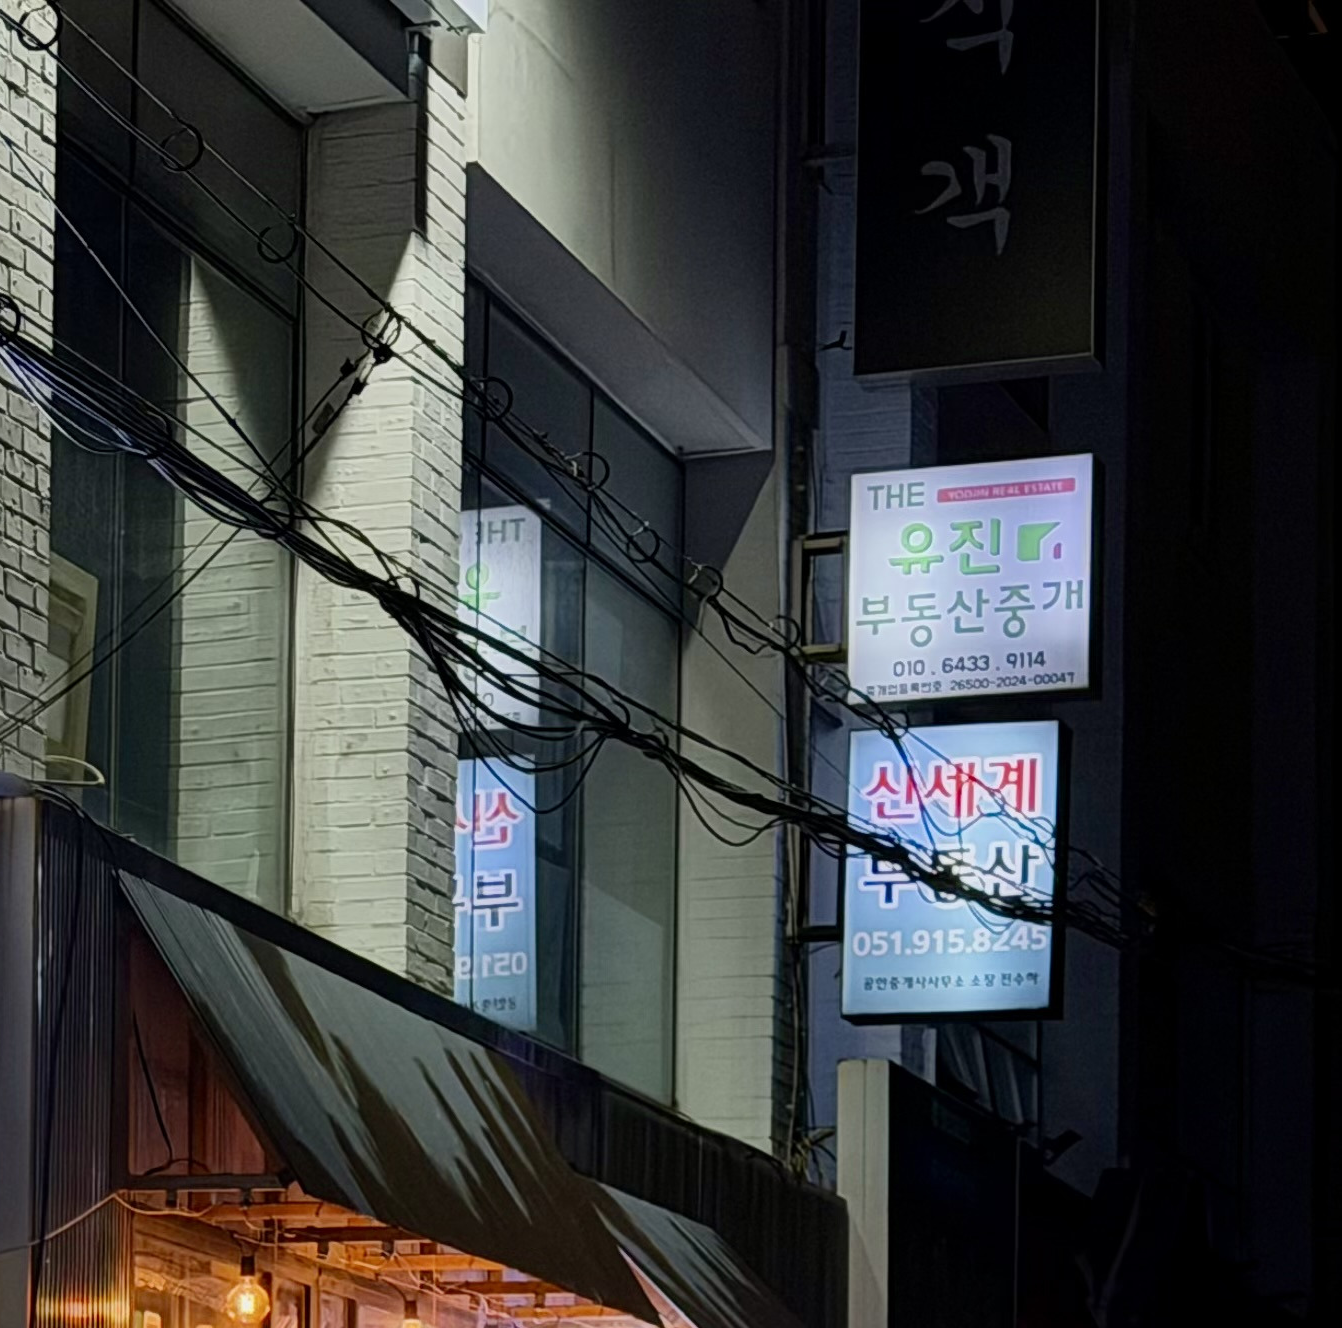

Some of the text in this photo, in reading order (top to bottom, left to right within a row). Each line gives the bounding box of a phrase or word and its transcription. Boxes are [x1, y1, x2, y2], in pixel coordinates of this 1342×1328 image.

[867, 482, 925, 511] THE
[888, 518, 1002, 575] 유진
[856, 579, 1085, 647] 부동산중개
[865, 757, 1037, 819] 신세계
[852, 925, 1048, 957] 051.915.8245
